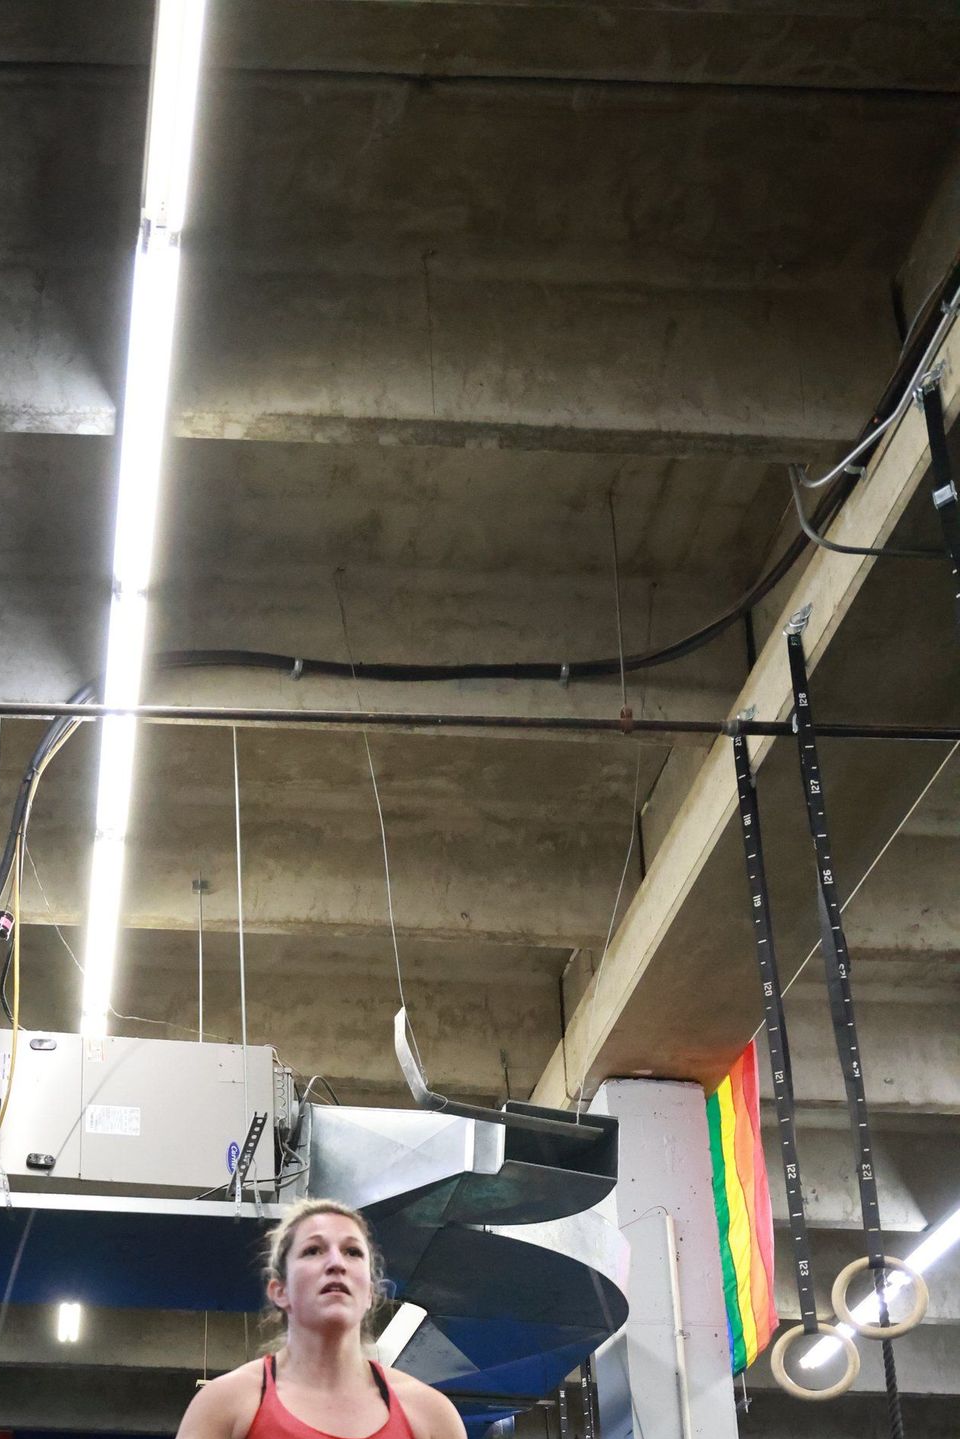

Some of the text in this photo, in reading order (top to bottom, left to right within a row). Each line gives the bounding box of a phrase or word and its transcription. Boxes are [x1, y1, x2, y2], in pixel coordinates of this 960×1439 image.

[799, 692, 809, 707] 128
[810, 779, 821, 794] 127
[743, 813, 752, 826] 118
[823, 869, 834, 885] 126
[753, 894, 762, 907] 119
[763, 981, 773, 997] 120
[774, 1070, 784, 1084] 121
[786, 1163, 797, 1180] 122
[862, 1163, 872, 1180] 123
[798, 1260, 809, 1277] 123
